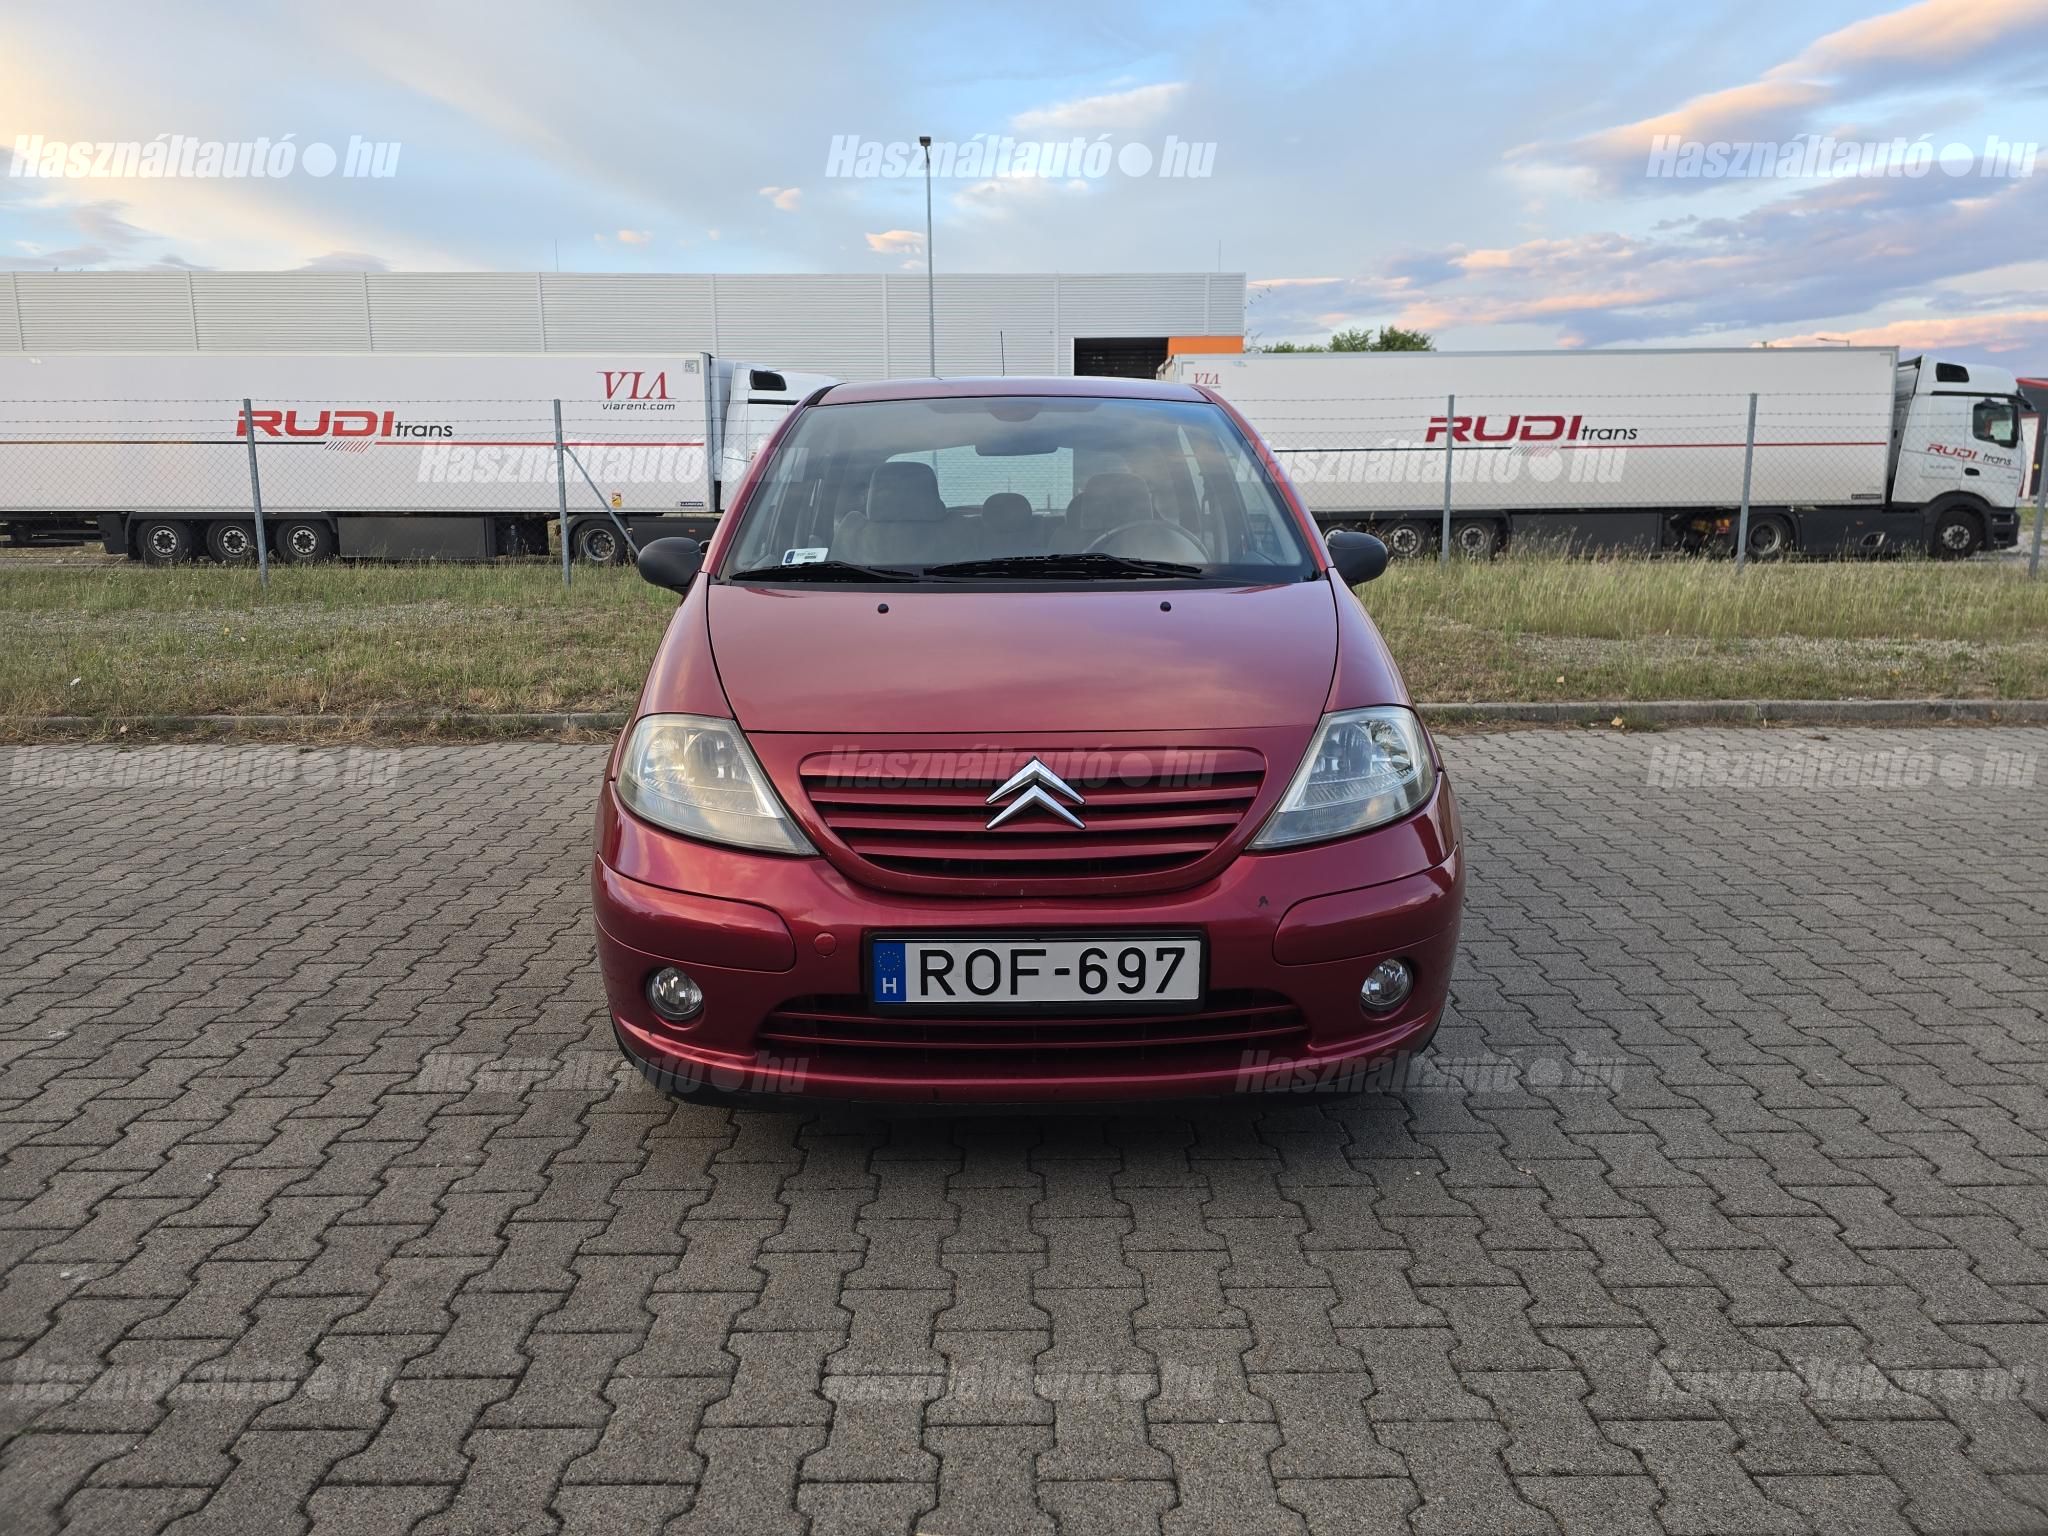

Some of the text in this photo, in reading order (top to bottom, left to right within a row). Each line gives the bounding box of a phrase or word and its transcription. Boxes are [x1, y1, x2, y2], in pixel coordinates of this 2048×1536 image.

[596, 371, 677, 399] VIA
[1193, 373, 1222, 384] VIA
[602, 402, 675, 410] viarent.com
[236, 410, 453, 437] RUDI trans
[1425, 415, 1638, 442] RUDI trans
[1927, 443, 2012, 465] RUDI trans
[919, 947, 1186, 996] ROF-697
[882, 977, 897, 994] H
